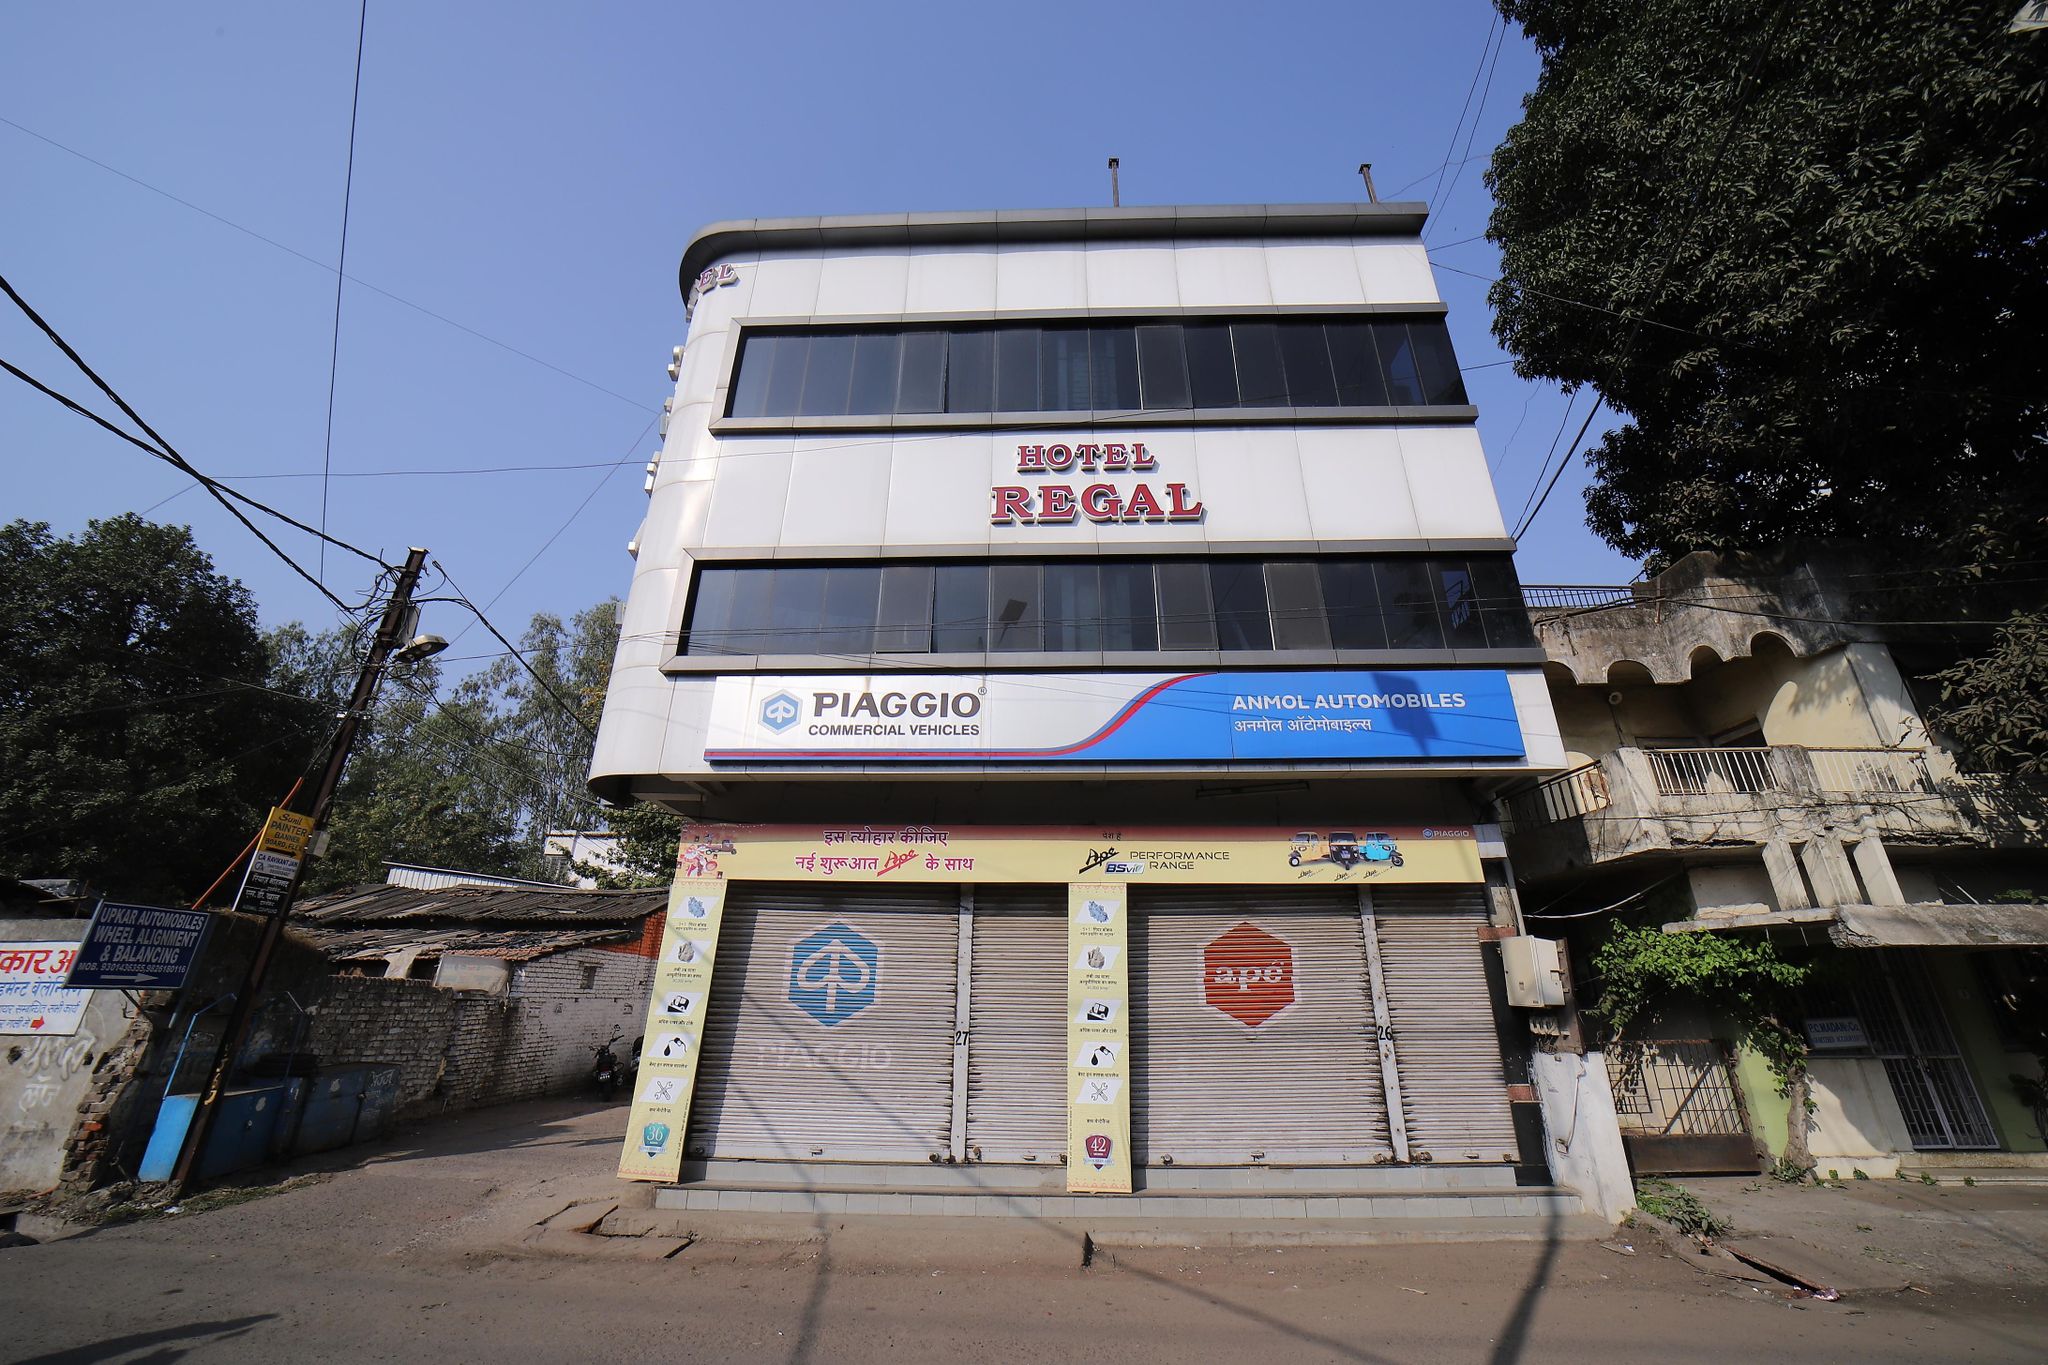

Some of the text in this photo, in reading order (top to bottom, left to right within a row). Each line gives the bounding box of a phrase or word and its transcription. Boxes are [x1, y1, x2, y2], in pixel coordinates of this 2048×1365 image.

[1017, 442, 1156, 471] HOTEL
[990, 483, 1204, 521] REGAL
[812, 691, 981, 718] PIAGGIO
[1232, 692, 1467, 710] ANMOL AUTOMOBILES
[808, 723, 980, 736] COMMERCIAL VEHICLES
[1234, 714, 1372, 733] अनमोल ऑटोमोबाइल्स
[270, 820, 308, 837] PAINTER
[823, 825, 950, 846] इस त्योहार कीजिए
[795, 852, 817, 871] नई
[925, 853, 975, 871] के साथ
[1130, 851, 1230, 860] PERFORMANCE
[1149, 861, 1195, 870] RANGE
[100, 907, 205, 930] UPKAR AUTOMOBILES
[93, 925, 199, 947] WHEEL ALIGNMENT
[0, 949, 53, 974] कार
[100, 944, 180, 964] & BALANCING
[77, 962, 98, 971] MOB.
[955, 1031, 969, 1046] 27
[1378, 1026, 1392, 1041] 26
[646, 1127, 664, 1142] 36
[1090, 1137, 1107, 1152] 42
